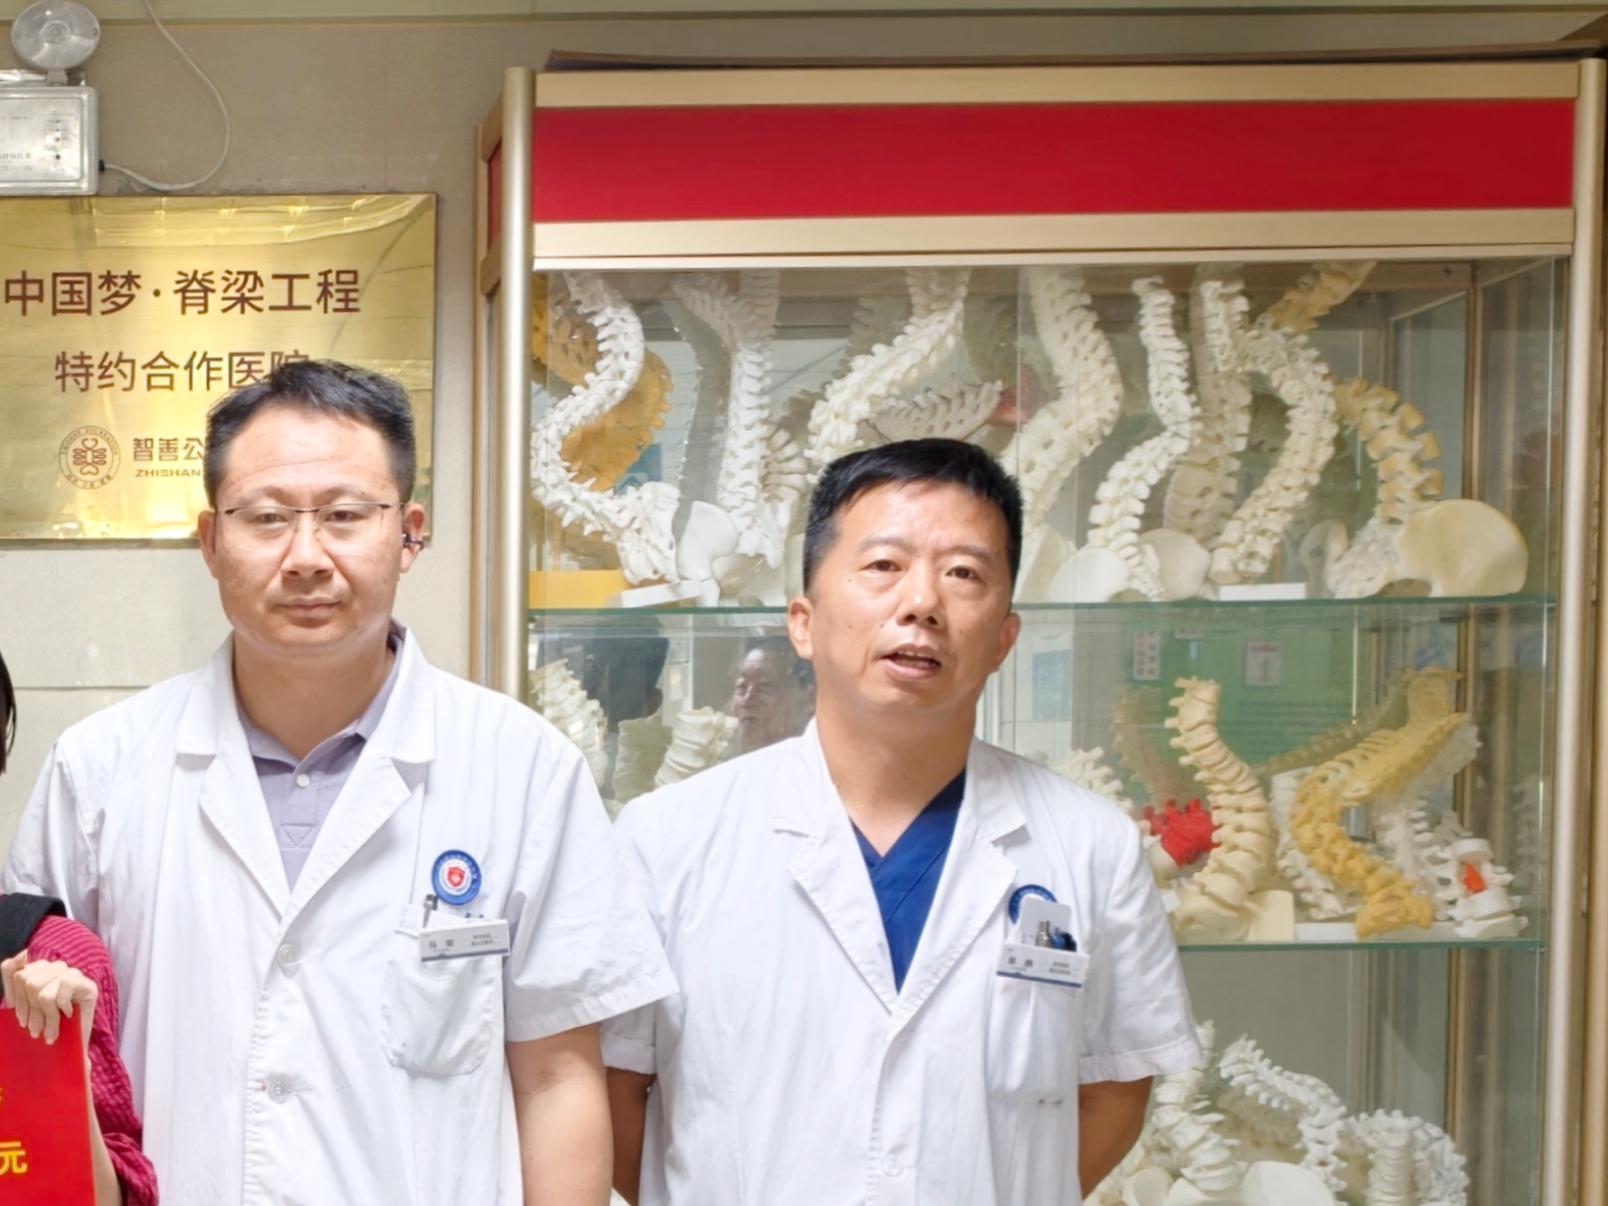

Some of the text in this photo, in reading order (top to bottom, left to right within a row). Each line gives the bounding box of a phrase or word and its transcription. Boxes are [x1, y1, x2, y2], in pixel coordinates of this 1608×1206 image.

[4, 269, 361, 316] 中国梦·脊梁工程
[135, 469, 202, 478] ZHISHAN
